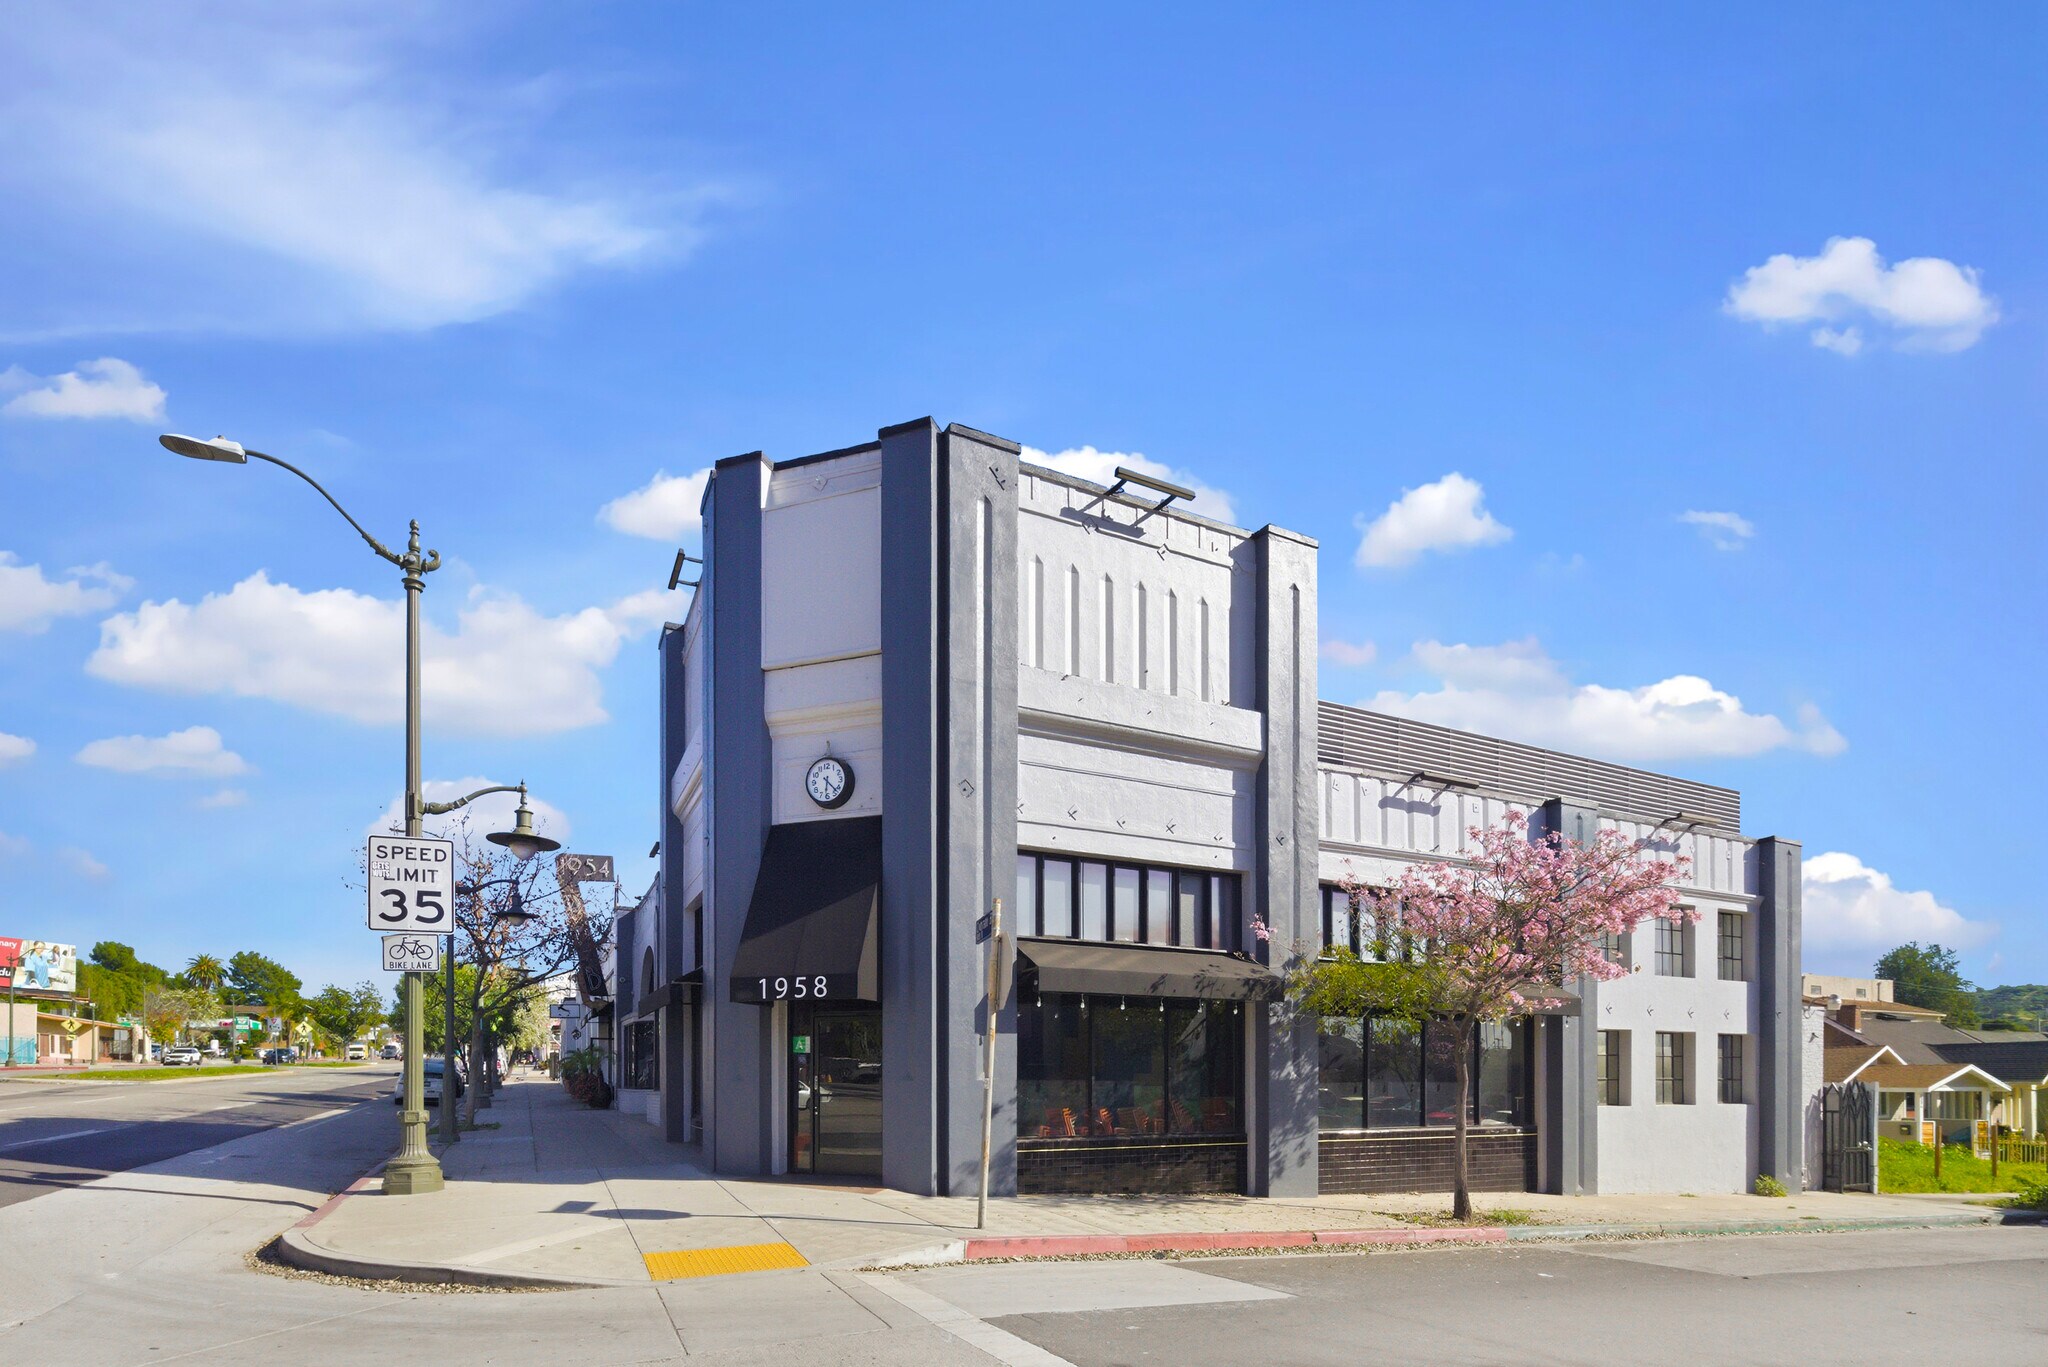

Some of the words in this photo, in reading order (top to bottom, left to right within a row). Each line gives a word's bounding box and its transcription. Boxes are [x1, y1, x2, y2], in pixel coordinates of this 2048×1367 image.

[376, 845, 447, 862] SPEED
[383, 868, 438, 883] LIMIT
[560, 857, 609, 877] 1954
[378, 888, 444, 924] 35
[759, 976, 827, 999] 1958
[795, 1040, 804, 1050] A
